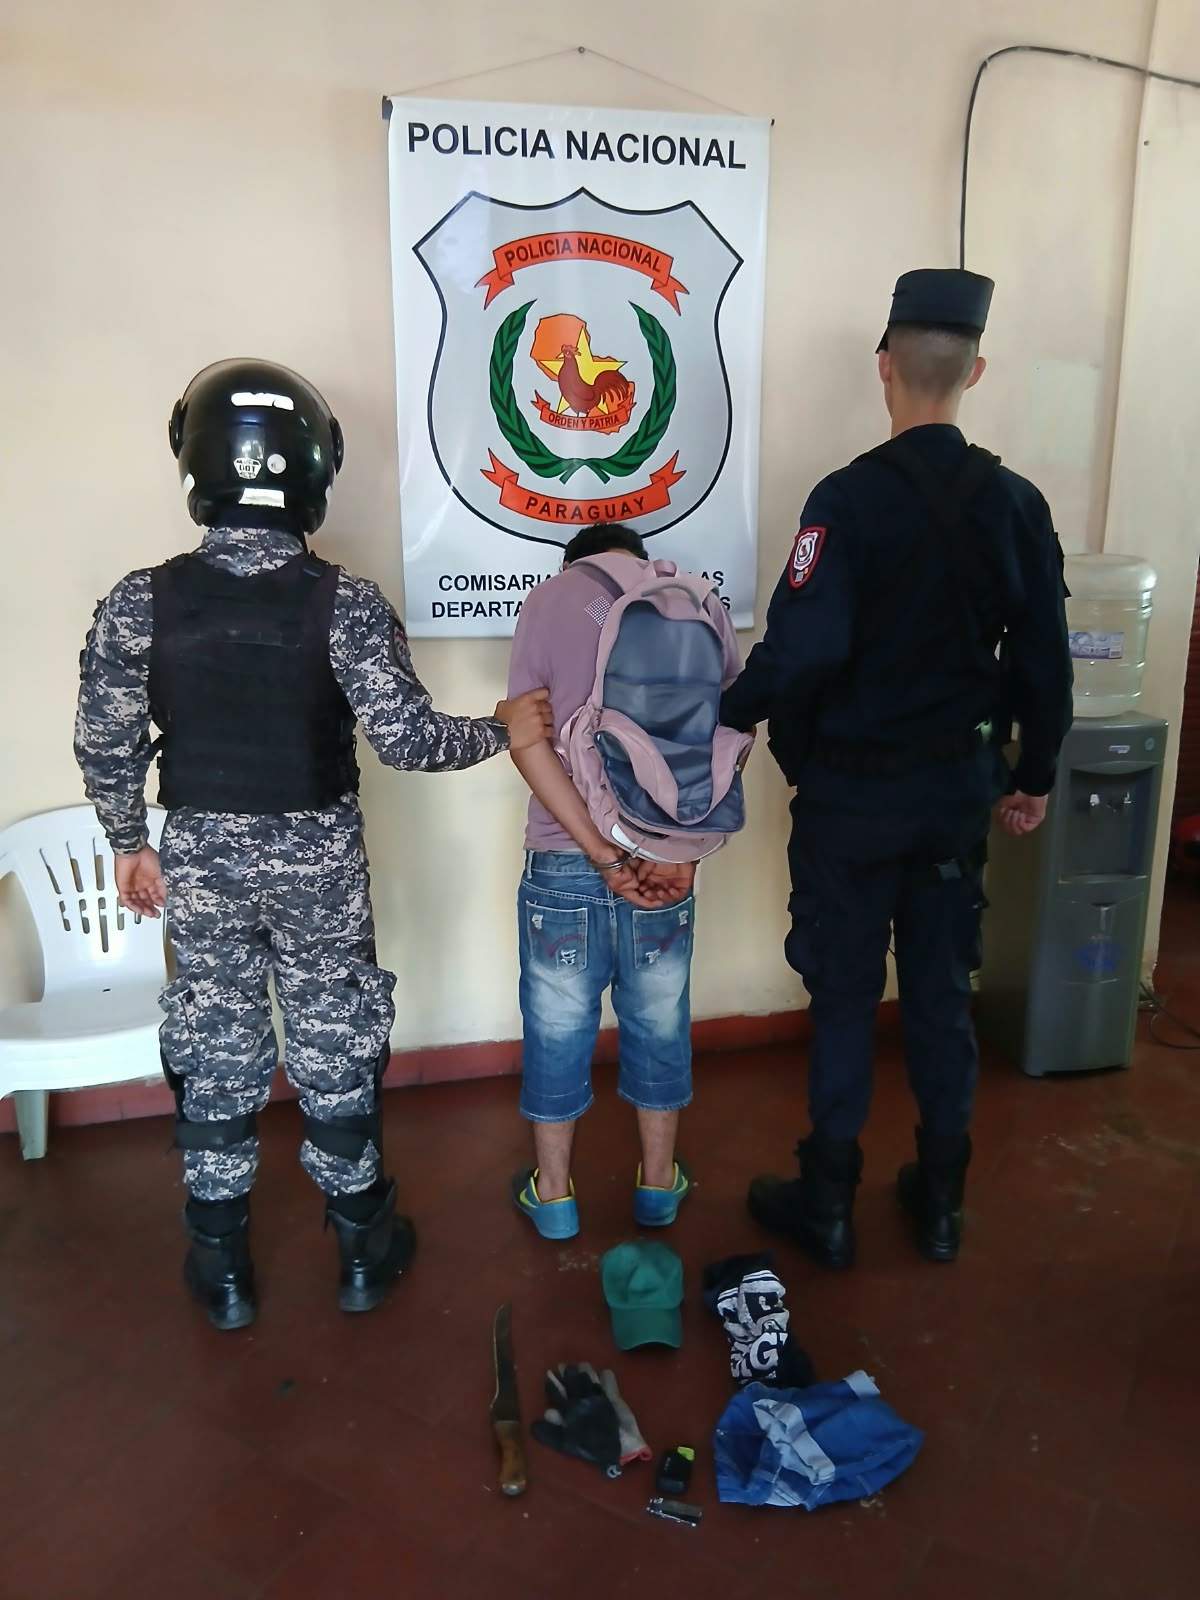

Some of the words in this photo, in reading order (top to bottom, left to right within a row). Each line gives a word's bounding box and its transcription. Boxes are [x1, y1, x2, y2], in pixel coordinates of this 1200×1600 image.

[407, 121, 555, 159] POLICIA
[565, 130, 747, 170] NACIONAL
[504, 238, 573, 267] POLICIA
[577, 237, 661, 273] NACIONAL
[548, 413, 579, 428] ORDEN
[581, 418, 587, 429] Y
[589, 414, 620, 429] PATRIA
[525, 496, 645, 521] PARAGUAY
[438, 574, 551, 591] COMISARI
